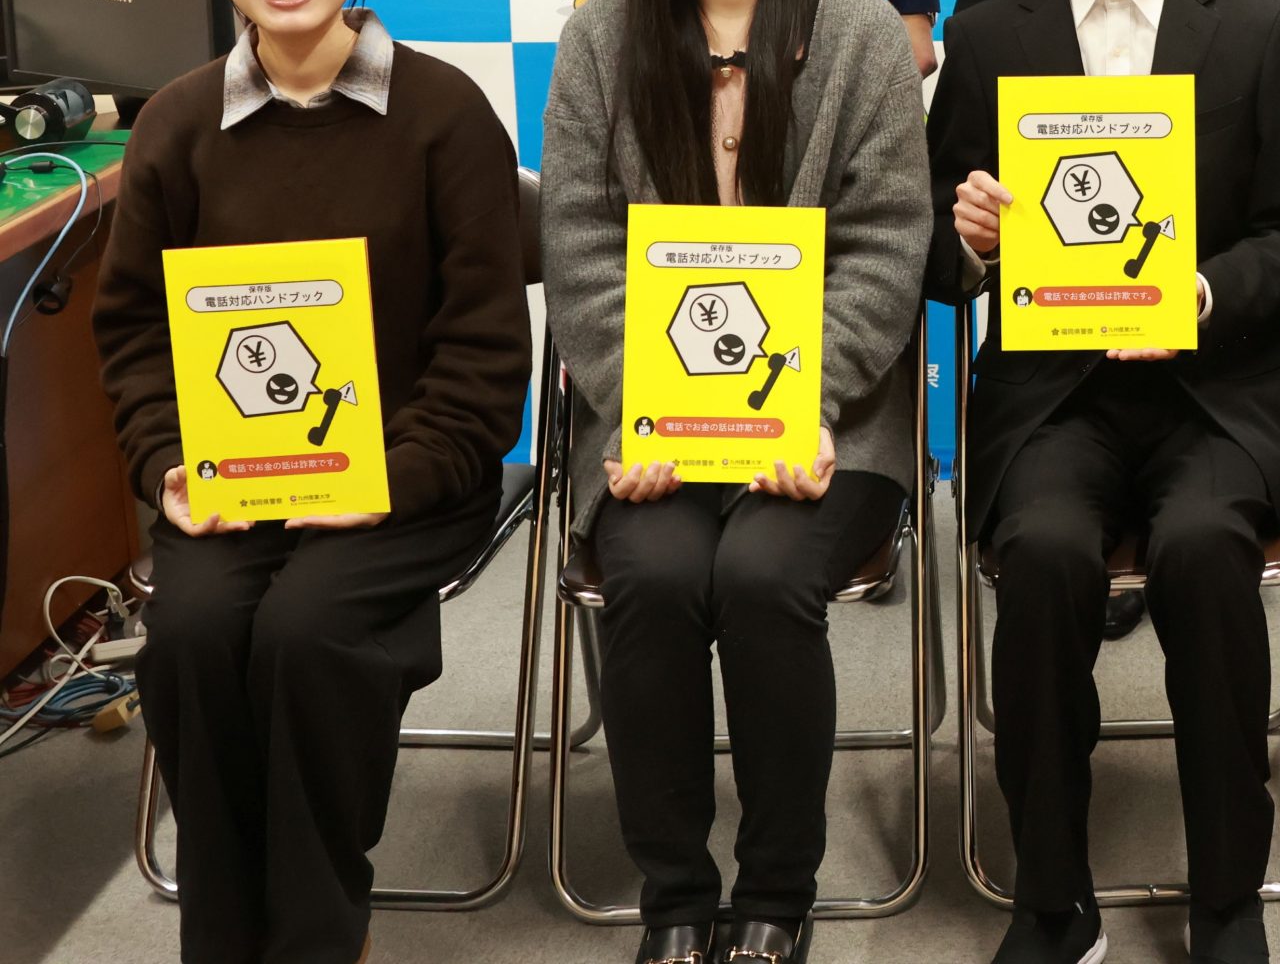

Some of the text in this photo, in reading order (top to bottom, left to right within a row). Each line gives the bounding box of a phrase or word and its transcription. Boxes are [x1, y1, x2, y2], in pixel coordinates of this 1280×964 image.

[1037, 124, 1152, 135] 電話対応ハンドブック
[665, 252, 782, 264] 電話対応ハンドブック
[205, 291, 323, 308] 電話対応ハンドブック
[1043, 292, 1152, 301] 電話でお金の話は詐欺です。
[665, 422, 775, 433] 電話でお金の話は詐欺です。
[228, 459, 340, 474] 電話でお金の話は詐欺です。
